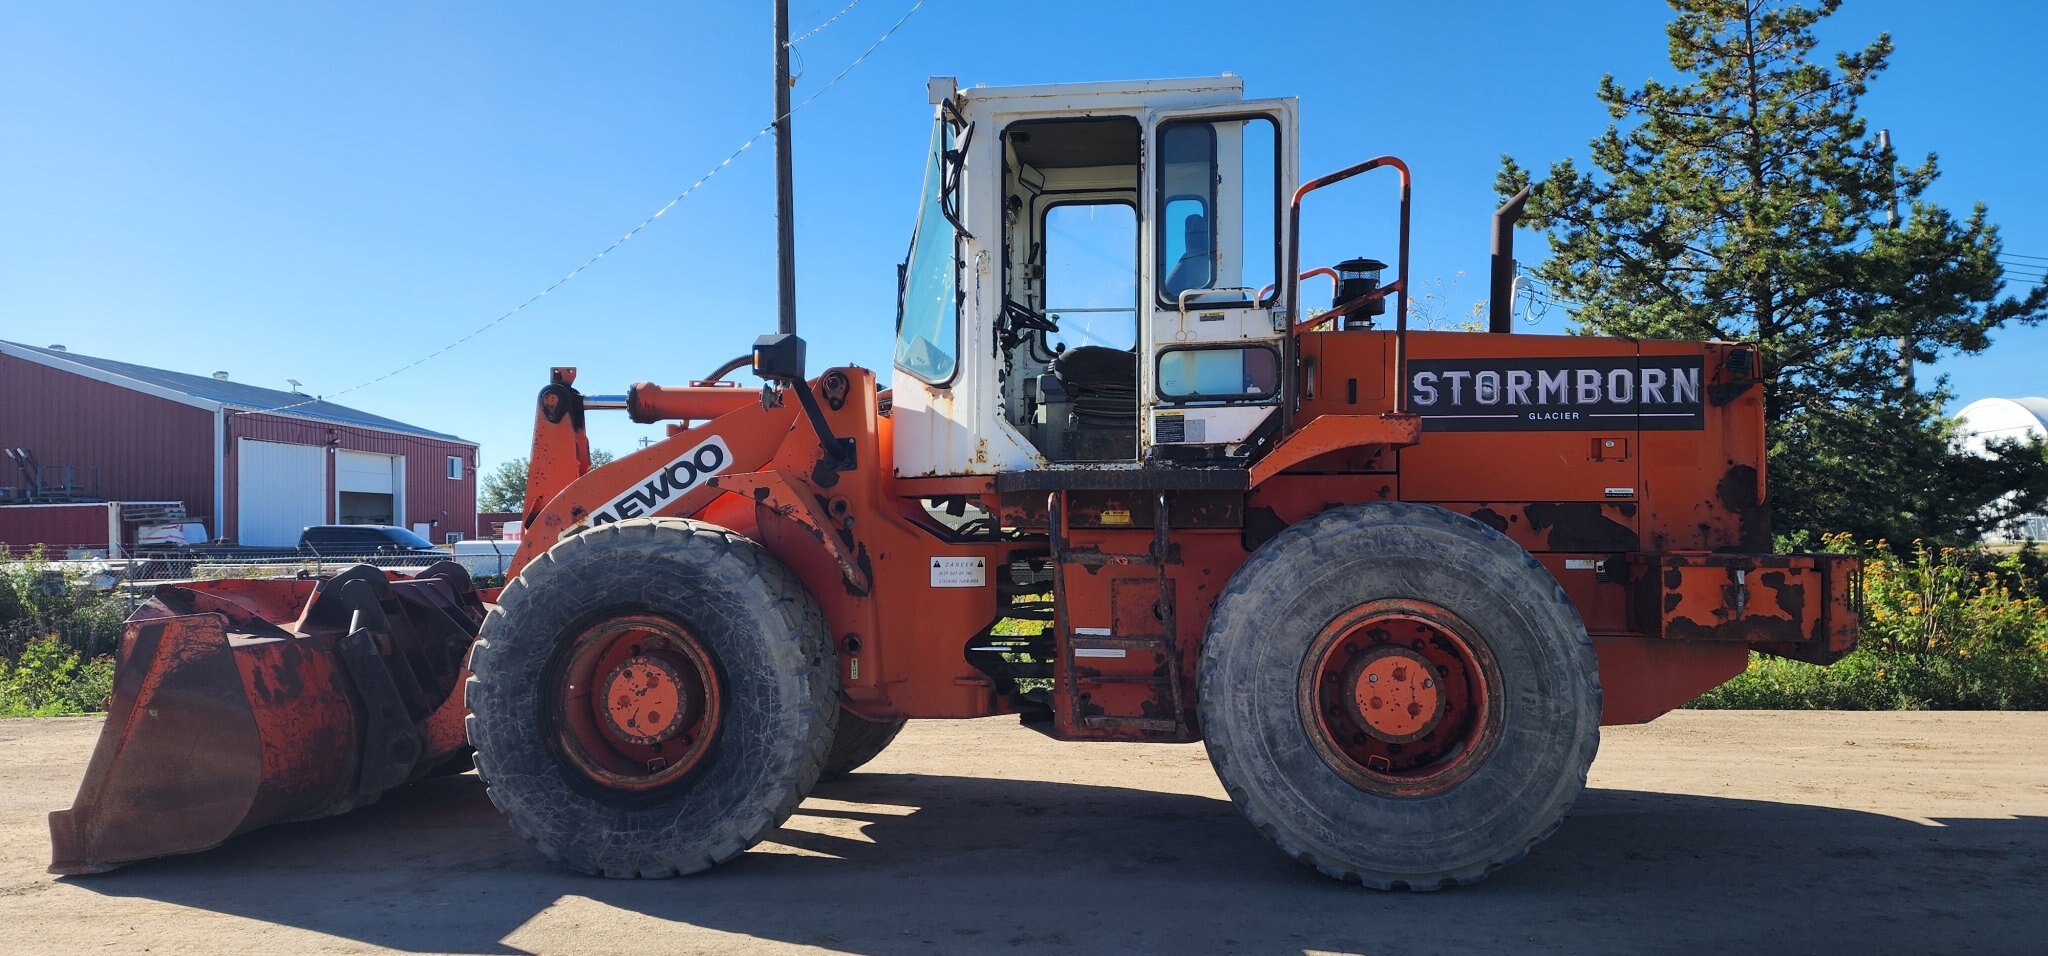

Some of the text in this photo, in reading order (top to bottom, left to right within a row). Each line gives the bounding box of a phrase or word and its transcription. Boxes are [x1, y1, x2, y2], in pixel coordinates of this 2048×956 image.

[1412, 368, 1700, 406] STORMBORN
[1528, 412, 1580, 420] GLACIER
[593, 444, 724, 528] AEWOO
